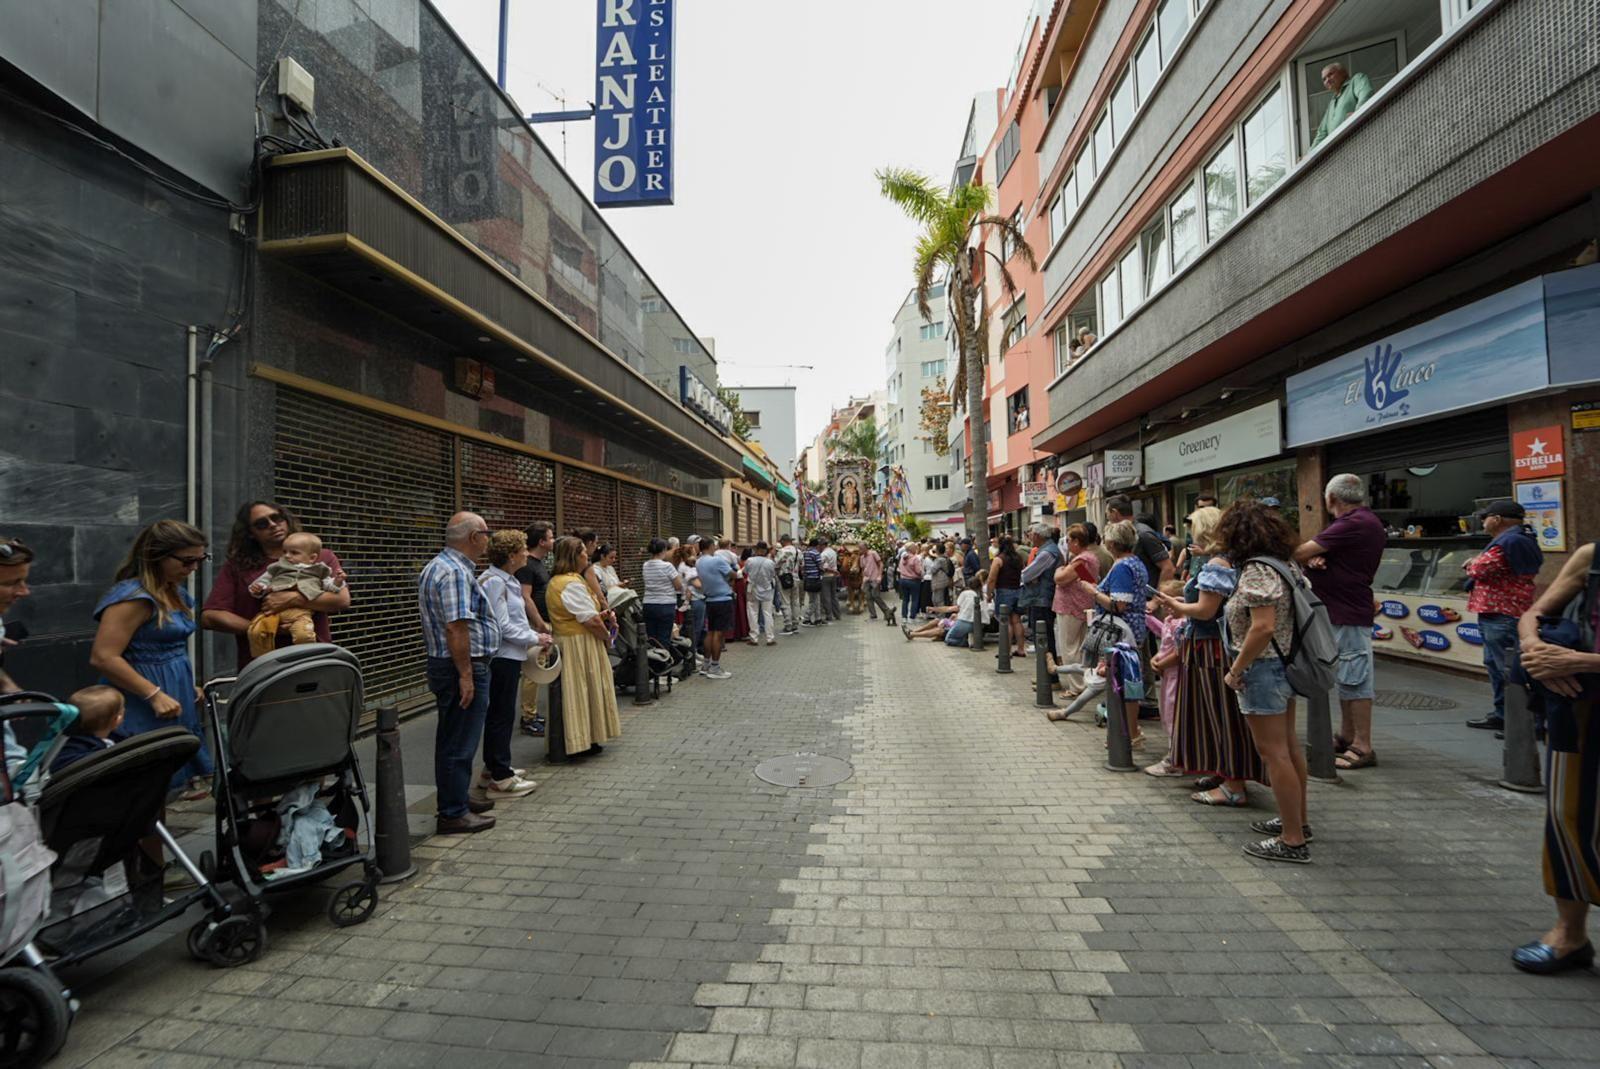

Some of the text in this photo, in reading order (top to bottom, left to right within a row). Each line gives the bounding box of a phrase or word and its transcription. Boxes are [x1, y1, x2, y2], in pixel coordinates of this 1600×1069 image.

[645, 44, 666, 191] LEATHER
[1179, 433, 1222, 456] Greenery
[1515, 453, 1563, 468] ESTRELLA
[1420, 608, 1438, 618] TAPAS
[1426, 634, 1444, 645] TABLA
